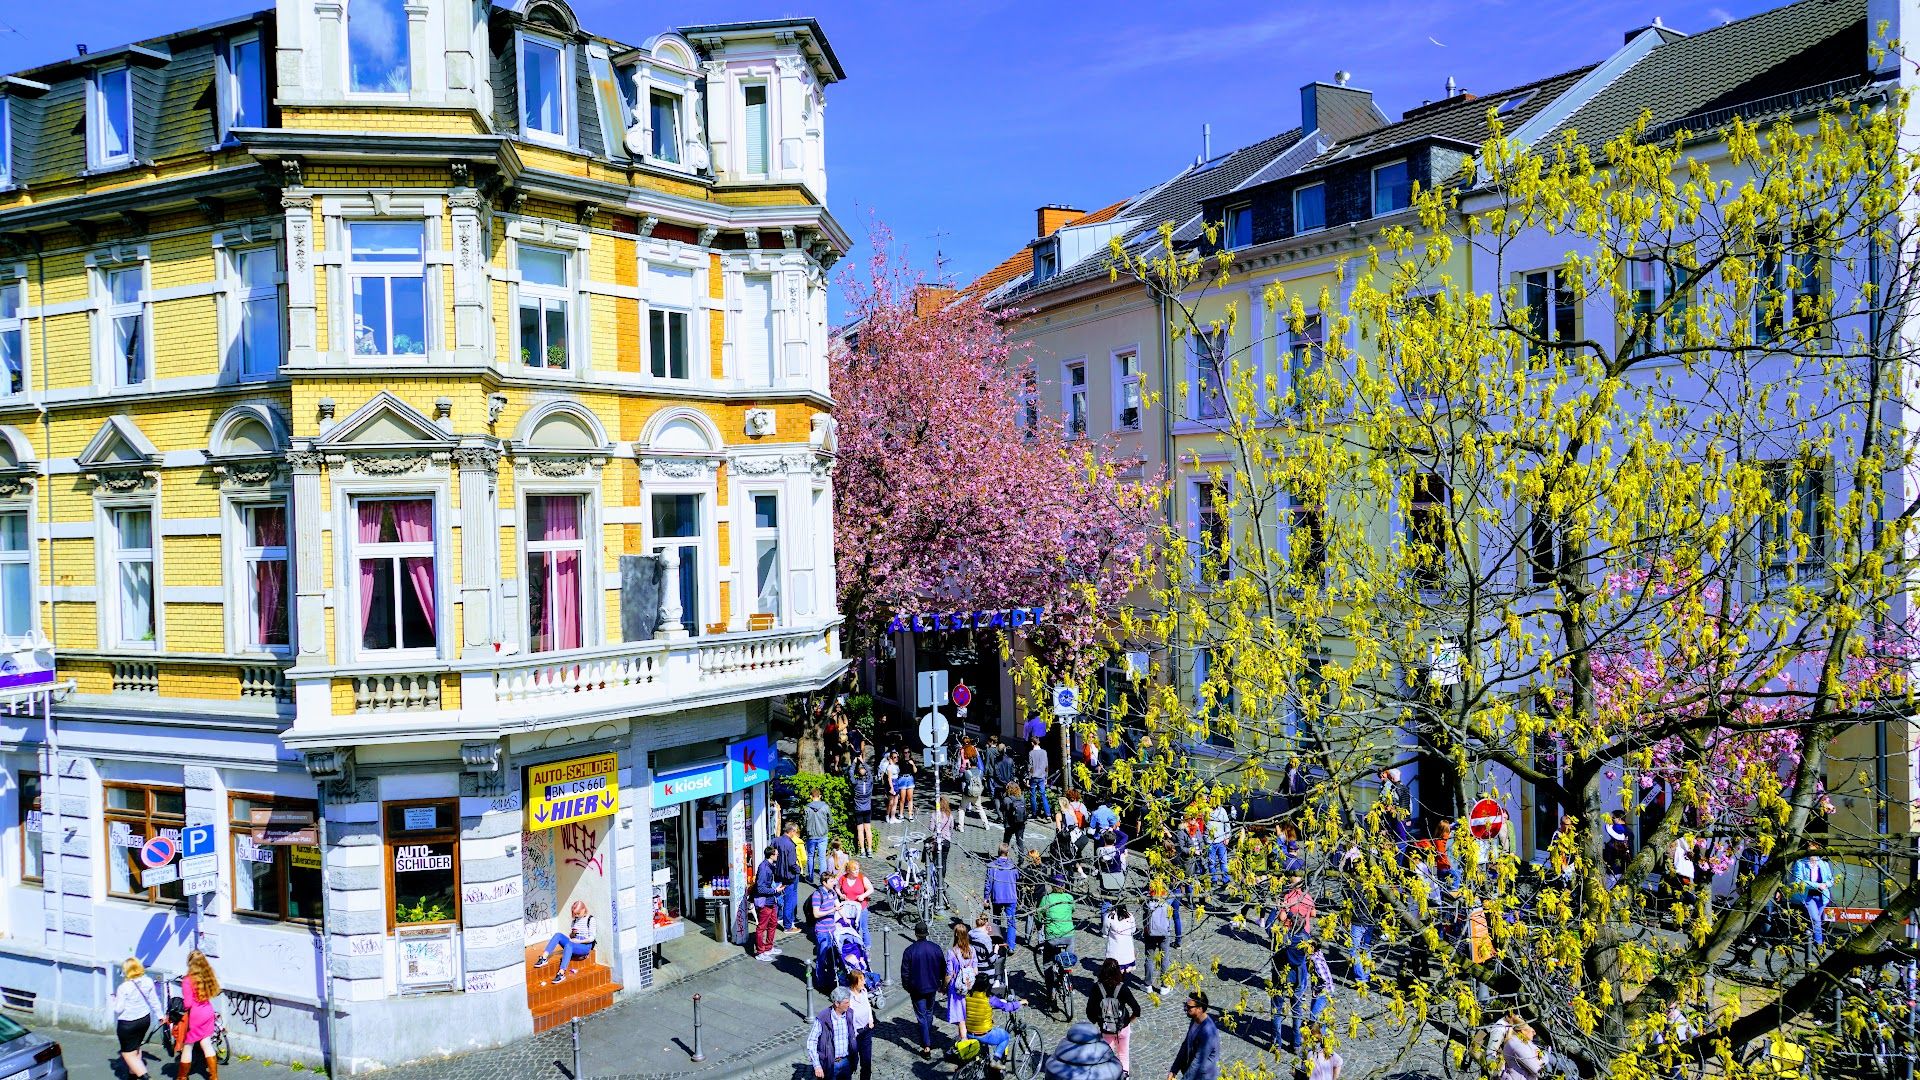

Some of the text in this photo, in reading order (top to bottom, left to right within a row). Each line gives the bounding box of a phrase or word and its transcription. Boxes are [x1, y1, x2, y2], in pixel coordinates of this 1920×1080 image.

[888, 608, 1044, 634] ALTSTADT
[675, 775, 713, 794] kiosk
[744, 773, 758, 783] kiosk
[552, 786, 565, 798] BN
[572, 780, 585, 794] CS
[551, 794, 599, 822] HIER
[189, 829, 208, 853] P
[397, 845, 433, 858] AUTO-
[397, 856, 451, 871] SCHILDER
